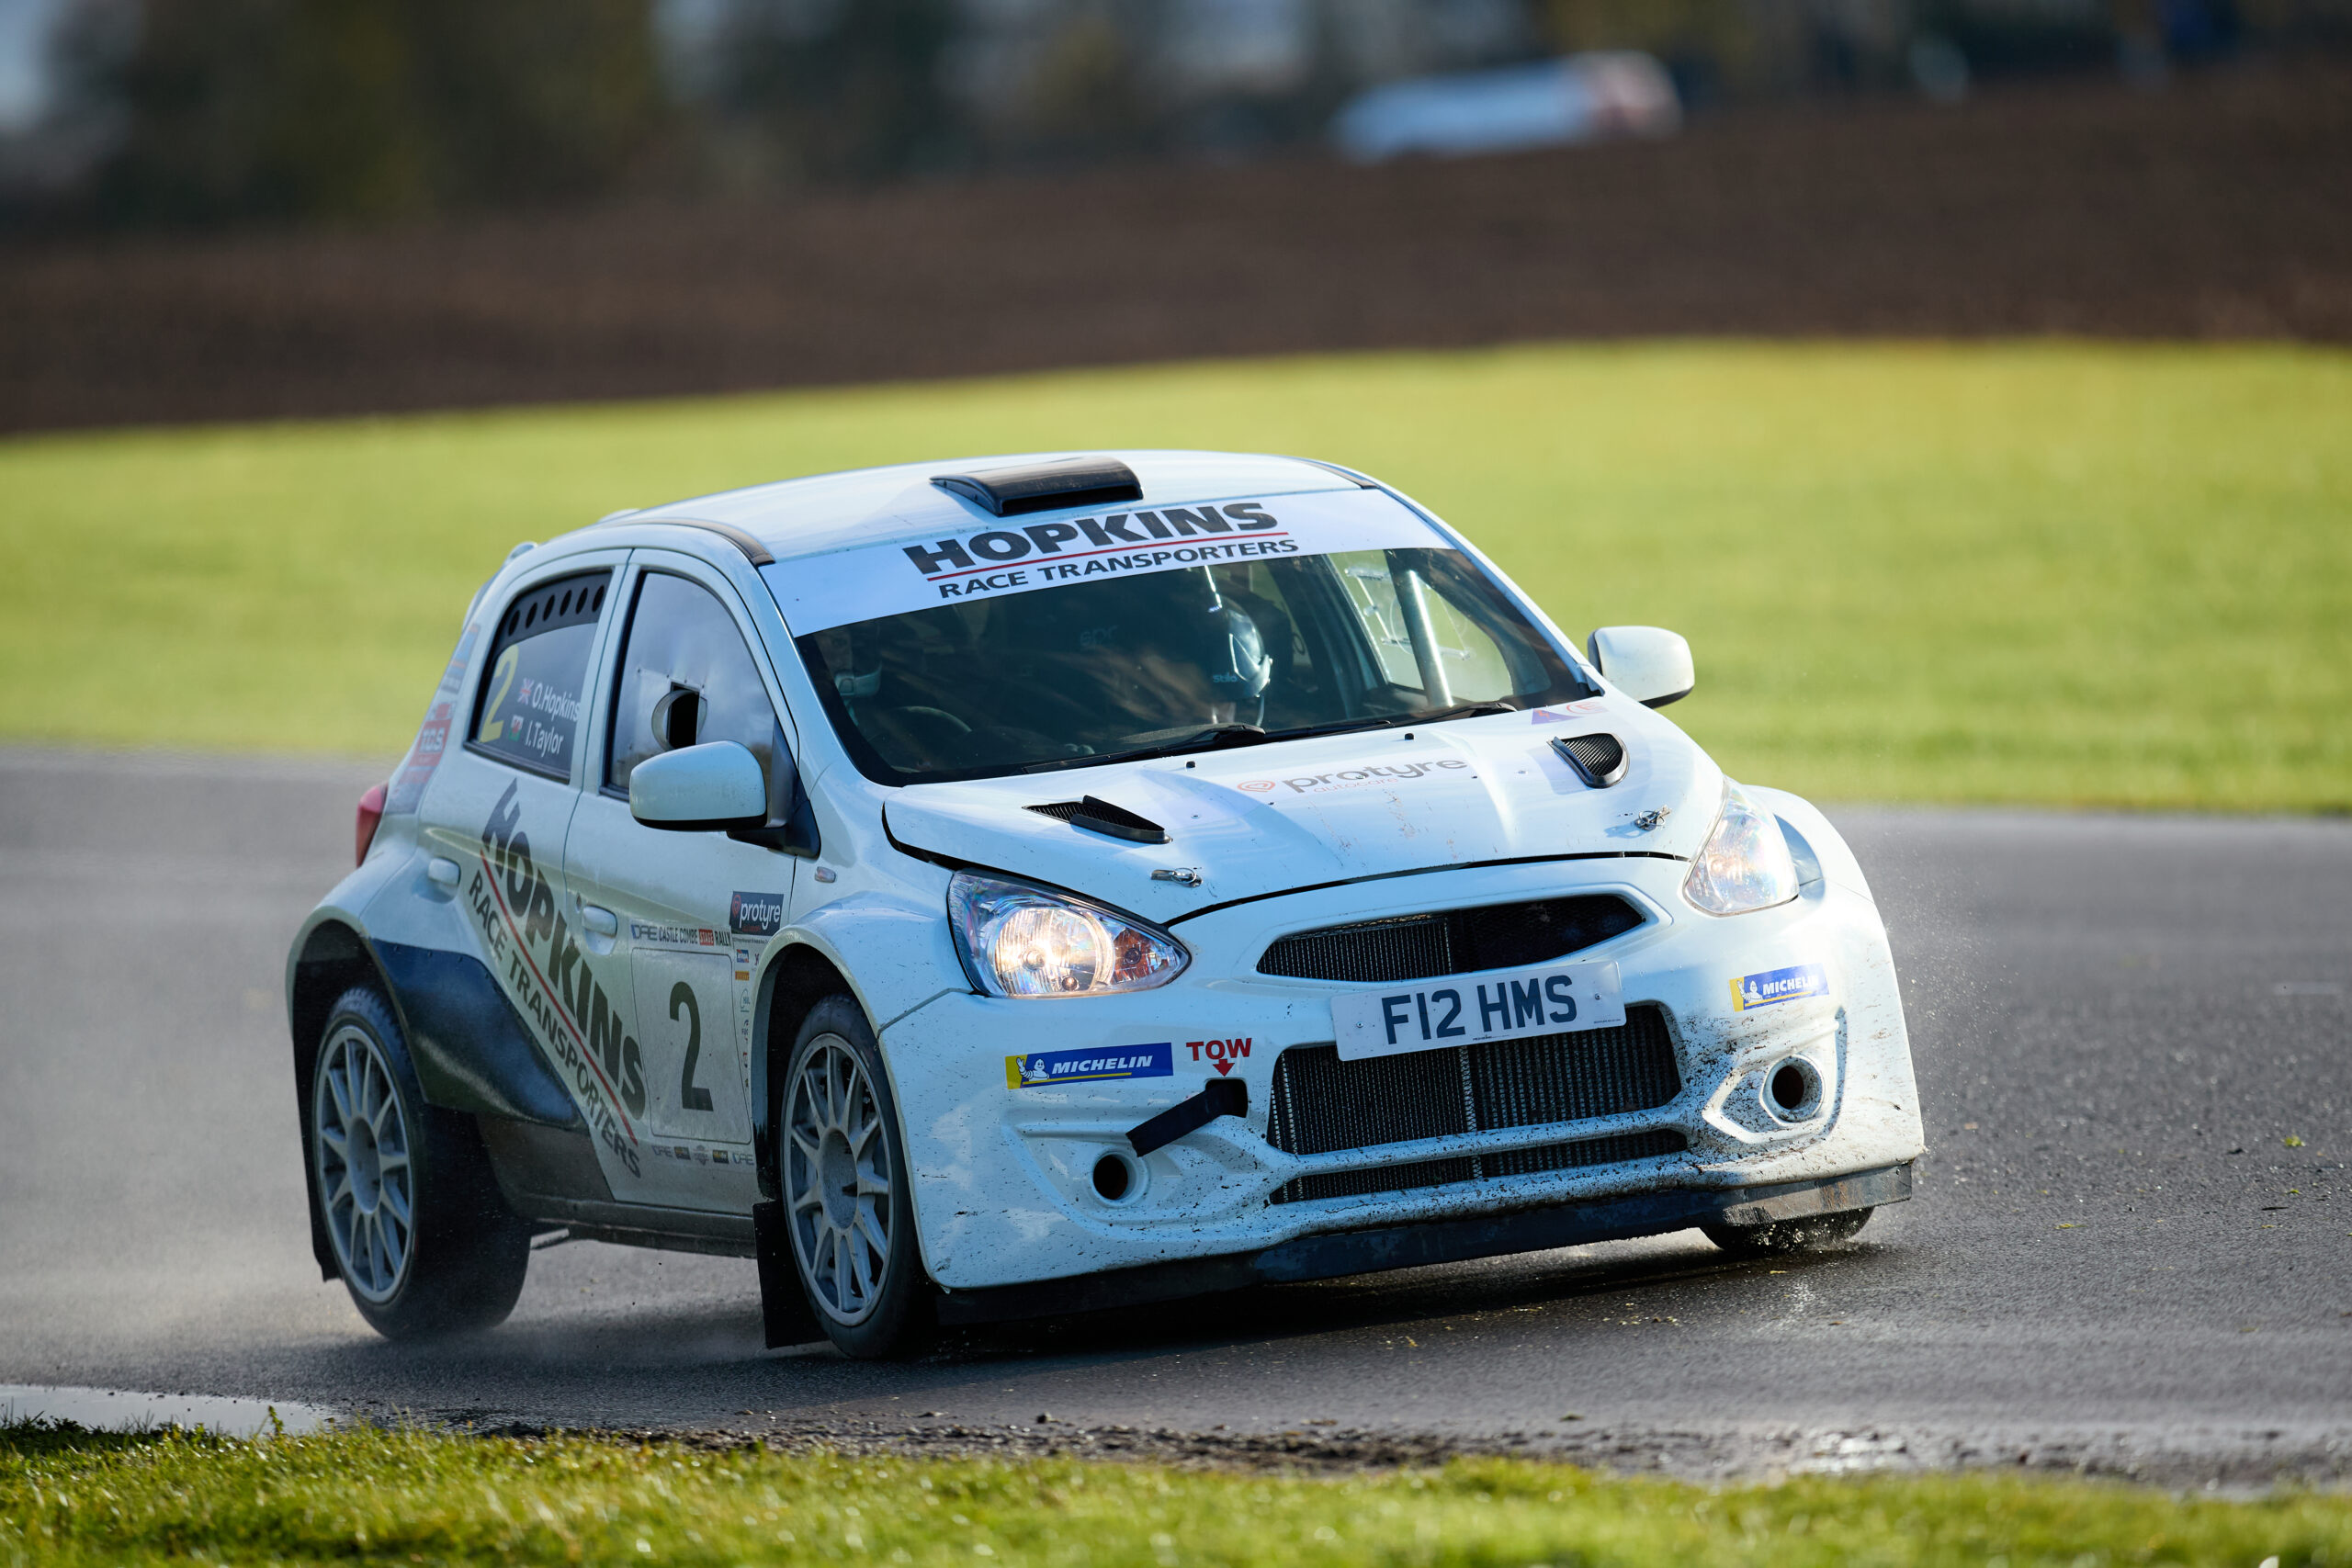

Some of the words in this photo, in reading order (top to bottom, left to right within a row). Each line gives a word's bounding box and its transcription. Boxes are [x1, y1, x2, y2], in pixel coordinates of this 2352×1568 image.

[902, 502, 1278, 574] HOPKINS
[939, 571, 1029, 598] RACE
[1037, 539, 1300, 582] TRANSPORTERS
[479, 644, 519, 743] 2
[532, 682, 581, 722] O.Hopkins
[525, 719, 565, 758] I.Taylor
[1282, 760, 1468, 793] protyre
[1314, 778, 1398, 793] autocare
[739, 899, 781, 930] protyre
[482, 777, 646, 1121] HOPKINS
[659, 927, 678, 942] CASTLE
[679, 928, 698, 943] COMBE
[699, 930, 714, 943] STAGE
[714, 931, 731, 946] RALLY
[1762, 975, 1819, 995] MICHELIN
[469, 871, 505, 962] RACE
[509, 950, 641, 1179] TRANSPORTERS
[1382, 989, 1465, 1044] F12
[1476, 975, 1577, 1032] HMS
[669, 981, 714, 1111] 2
[1052, 1055, 1153, 1075] MICHELIN
[1186, 1037, 1252, 1061] TOW
